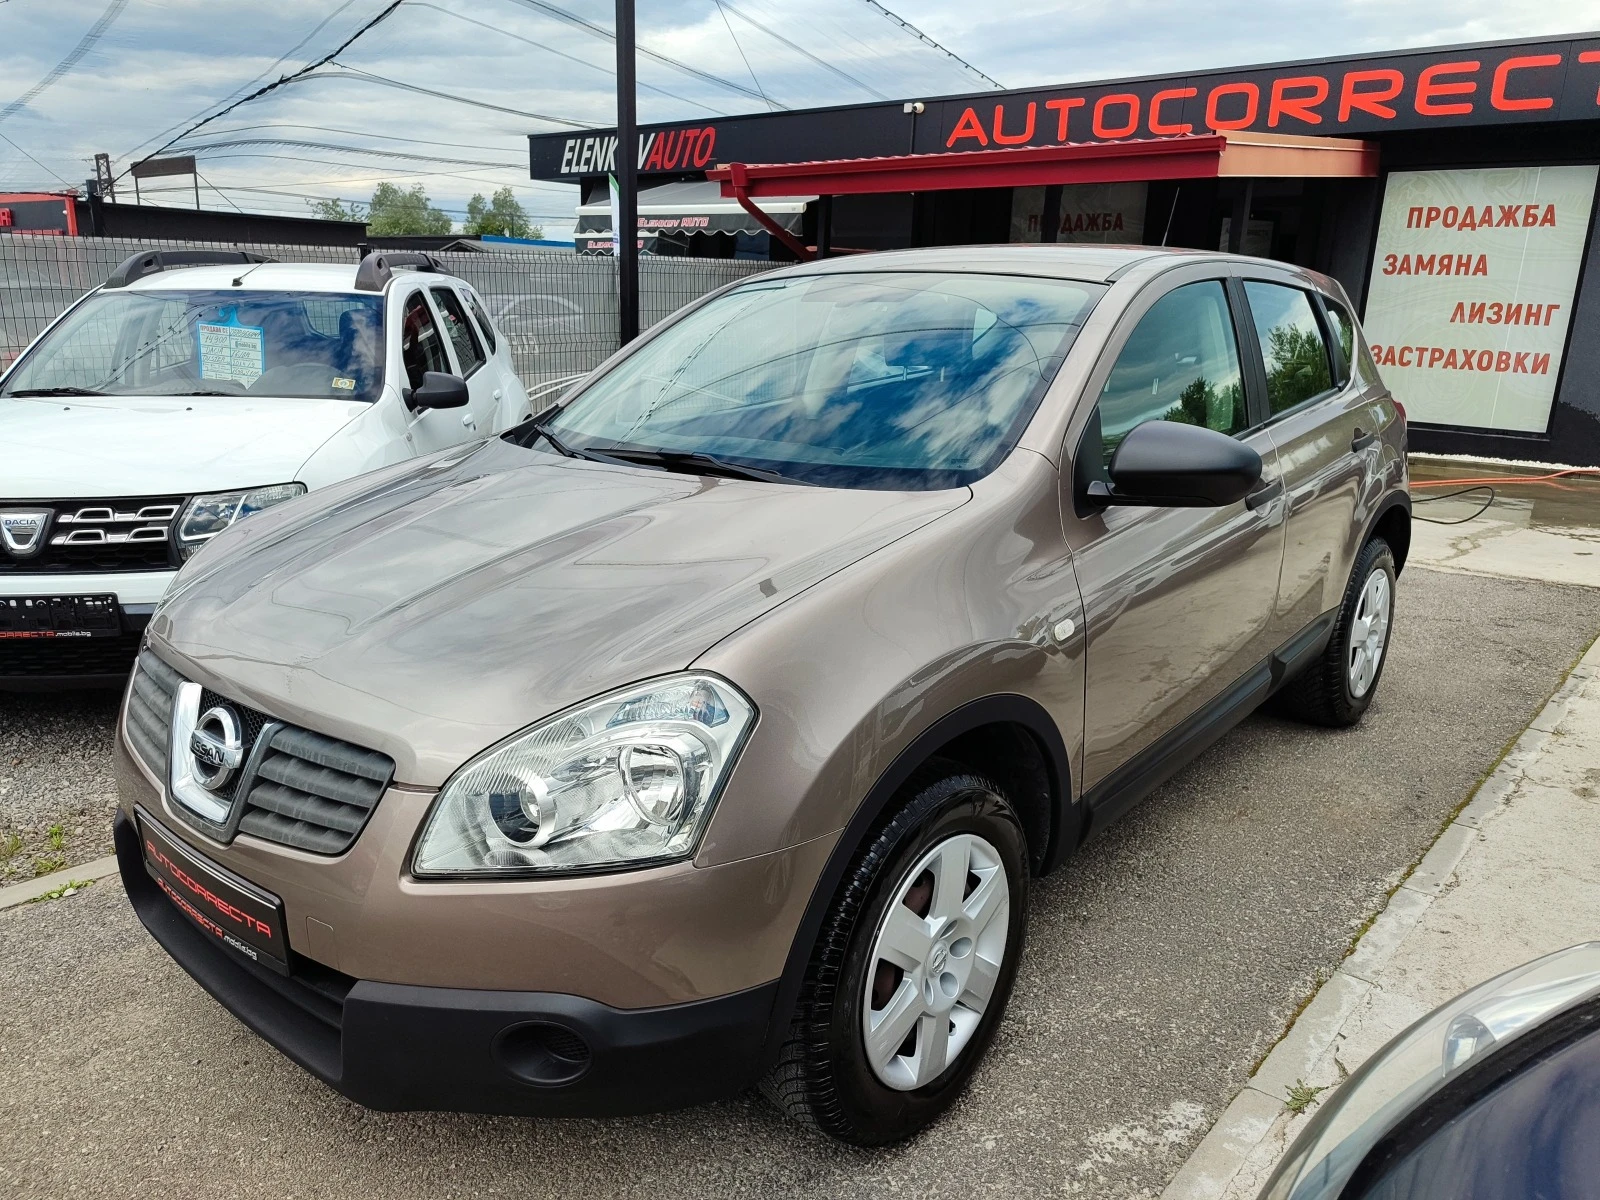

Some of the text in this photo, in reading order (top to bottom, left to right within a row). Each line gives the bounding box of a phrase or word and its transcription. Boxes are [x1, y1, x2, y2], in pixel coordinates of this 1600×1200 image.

[1027, 212, 1124, 234] ПДАЖБА
[1406, 204, 1557, 231] ПРОДАЖБА
[1382, 254, 1488, 276] ЗАМЯНА
[1450, 302, 1560, 326] ЛИЗИНГ
[1371, 345, 1550, 374] ЗАСТРАХОВКИ
[146, 839, 272, 939] AUTOCORRECTA
